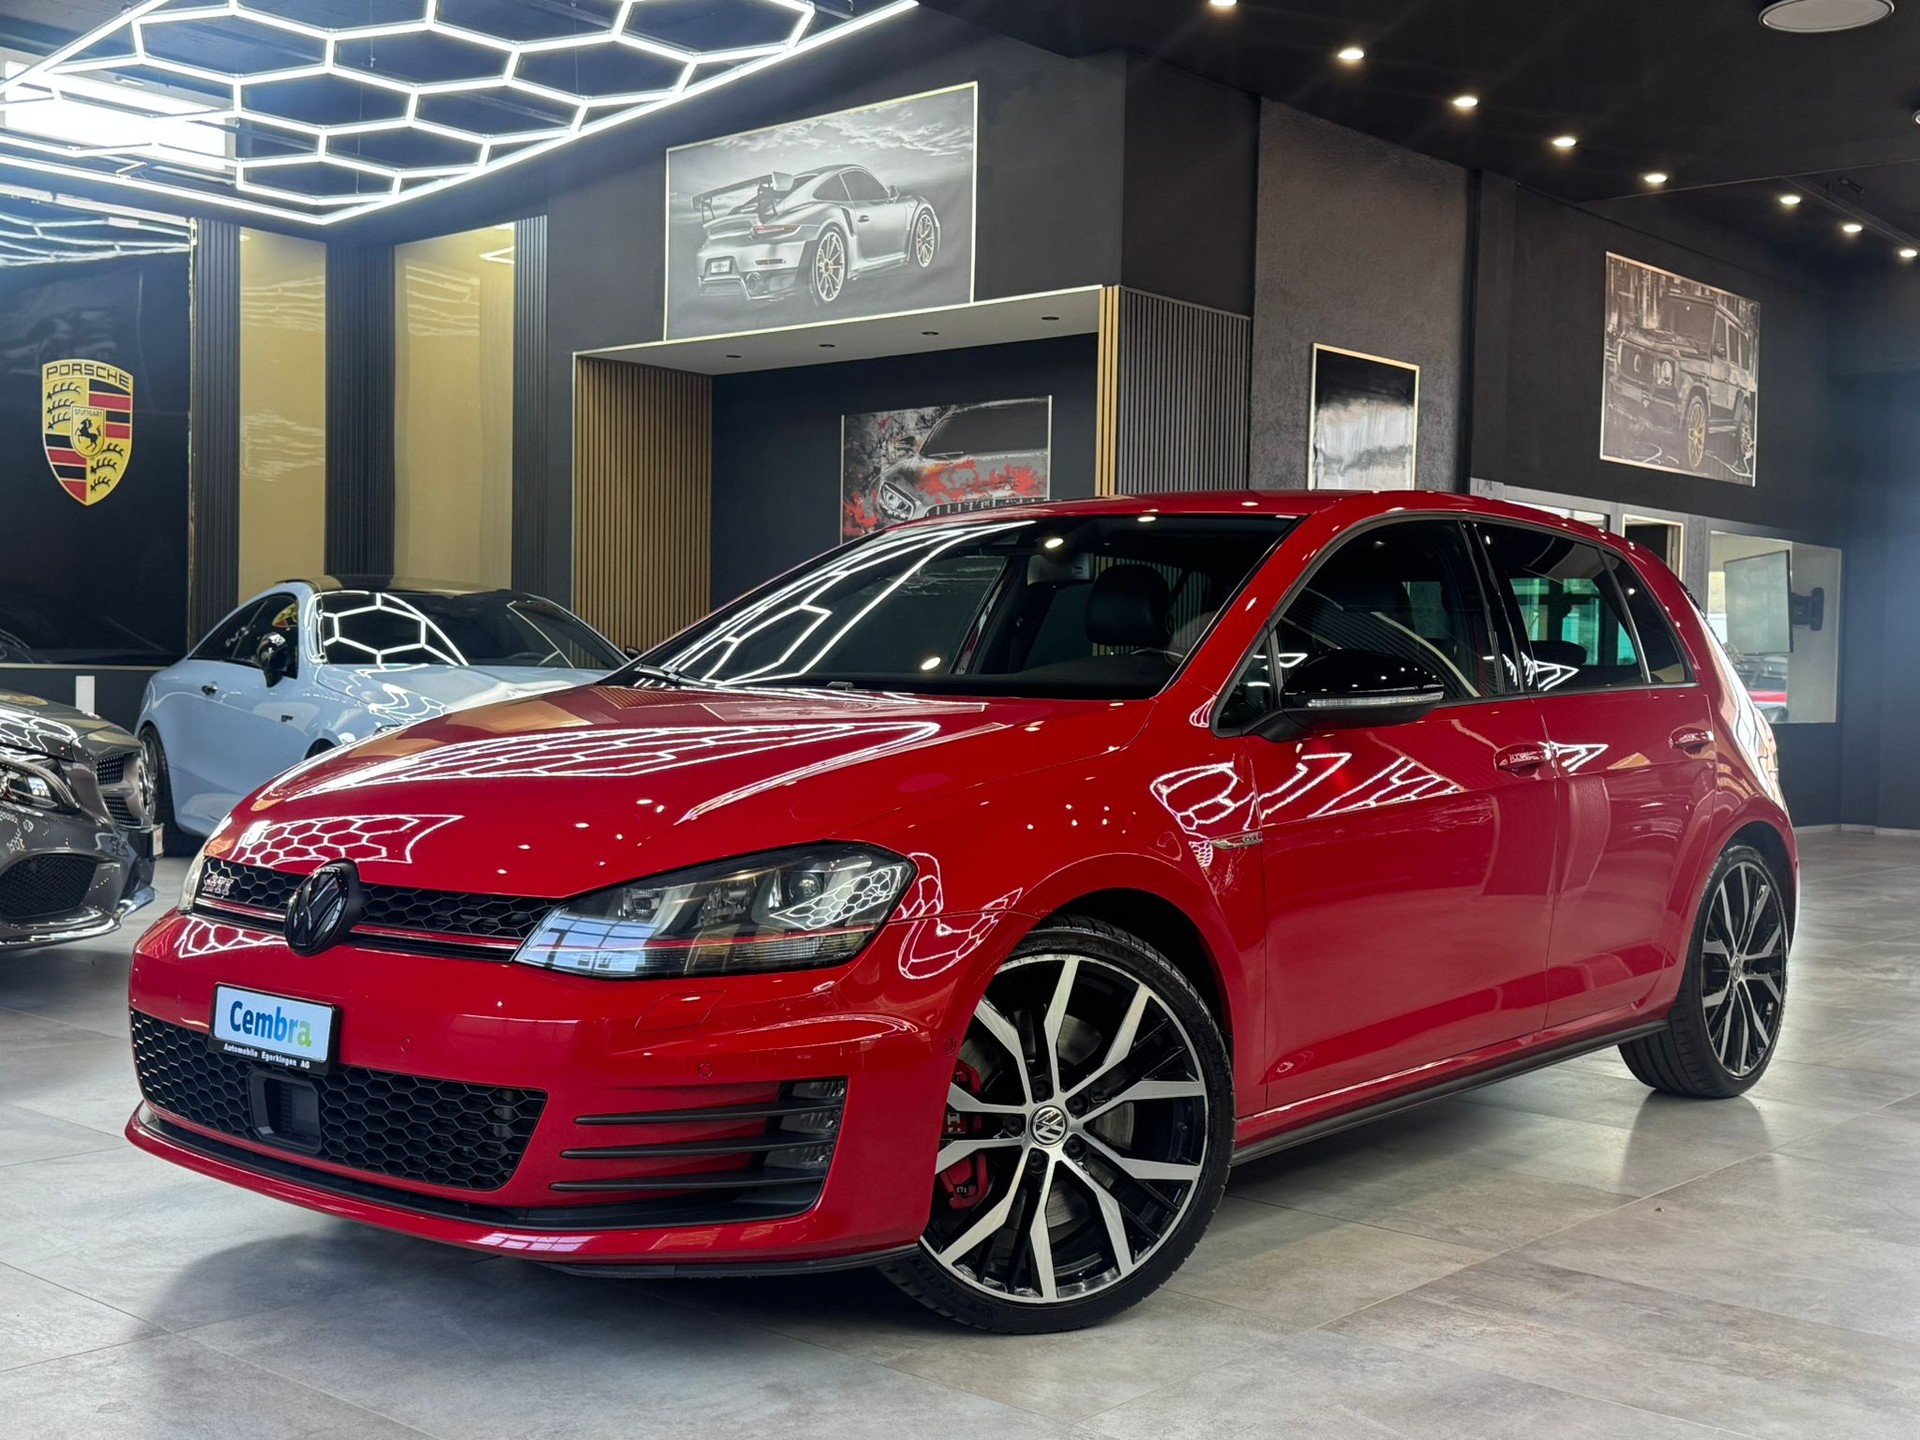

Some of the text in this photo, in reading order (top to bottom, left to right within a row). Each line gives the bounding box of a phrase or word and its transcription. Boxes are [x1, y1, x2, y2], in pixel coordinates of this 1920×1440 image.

[46, 363, 130, 391] PORSCHE
[229, 1000, 312, 1048] Cembra
[223, 1042, 311, 1070] Automobile Egerkingen AG
